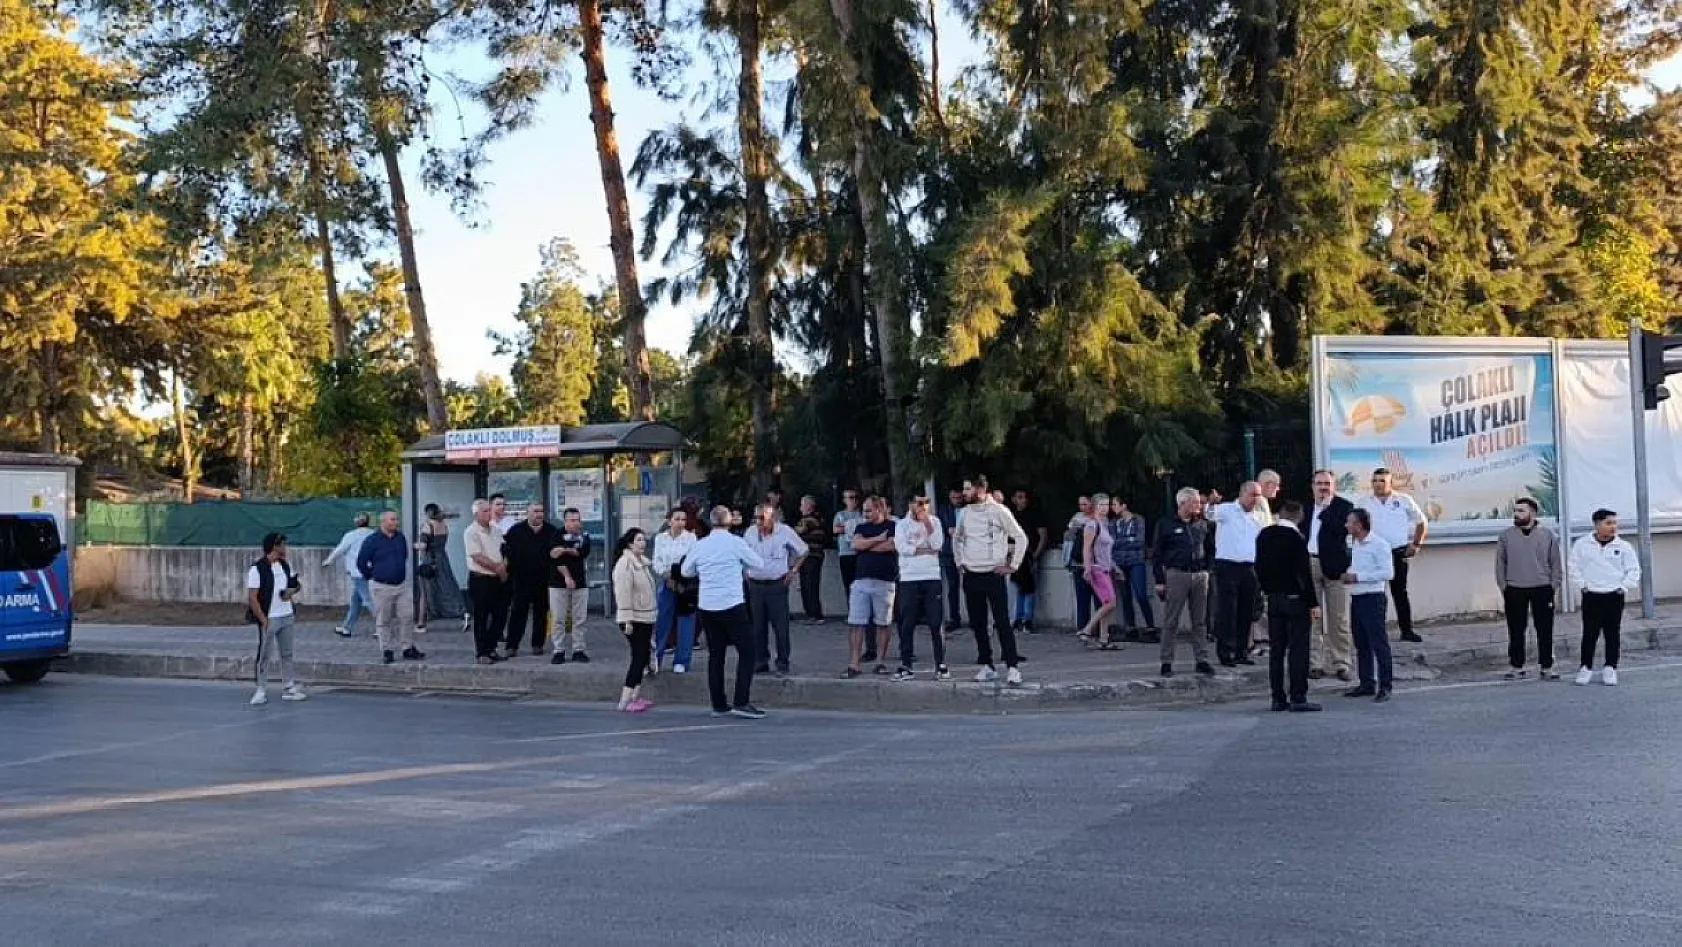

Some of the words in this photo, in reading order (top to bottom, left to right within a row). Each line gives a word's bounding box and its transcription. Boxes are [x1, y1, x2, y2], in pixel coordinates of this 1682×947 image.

[1441, 366, 1514, 412] ÇOLAKLI
[449, 431, 490, 449] ÇOLAKLI
[1431, 407, 1475, 444] HALK
[1481, 395, 1526, 432] PLAJI
[1467, 423, 1528, 461] AÇILDI!
